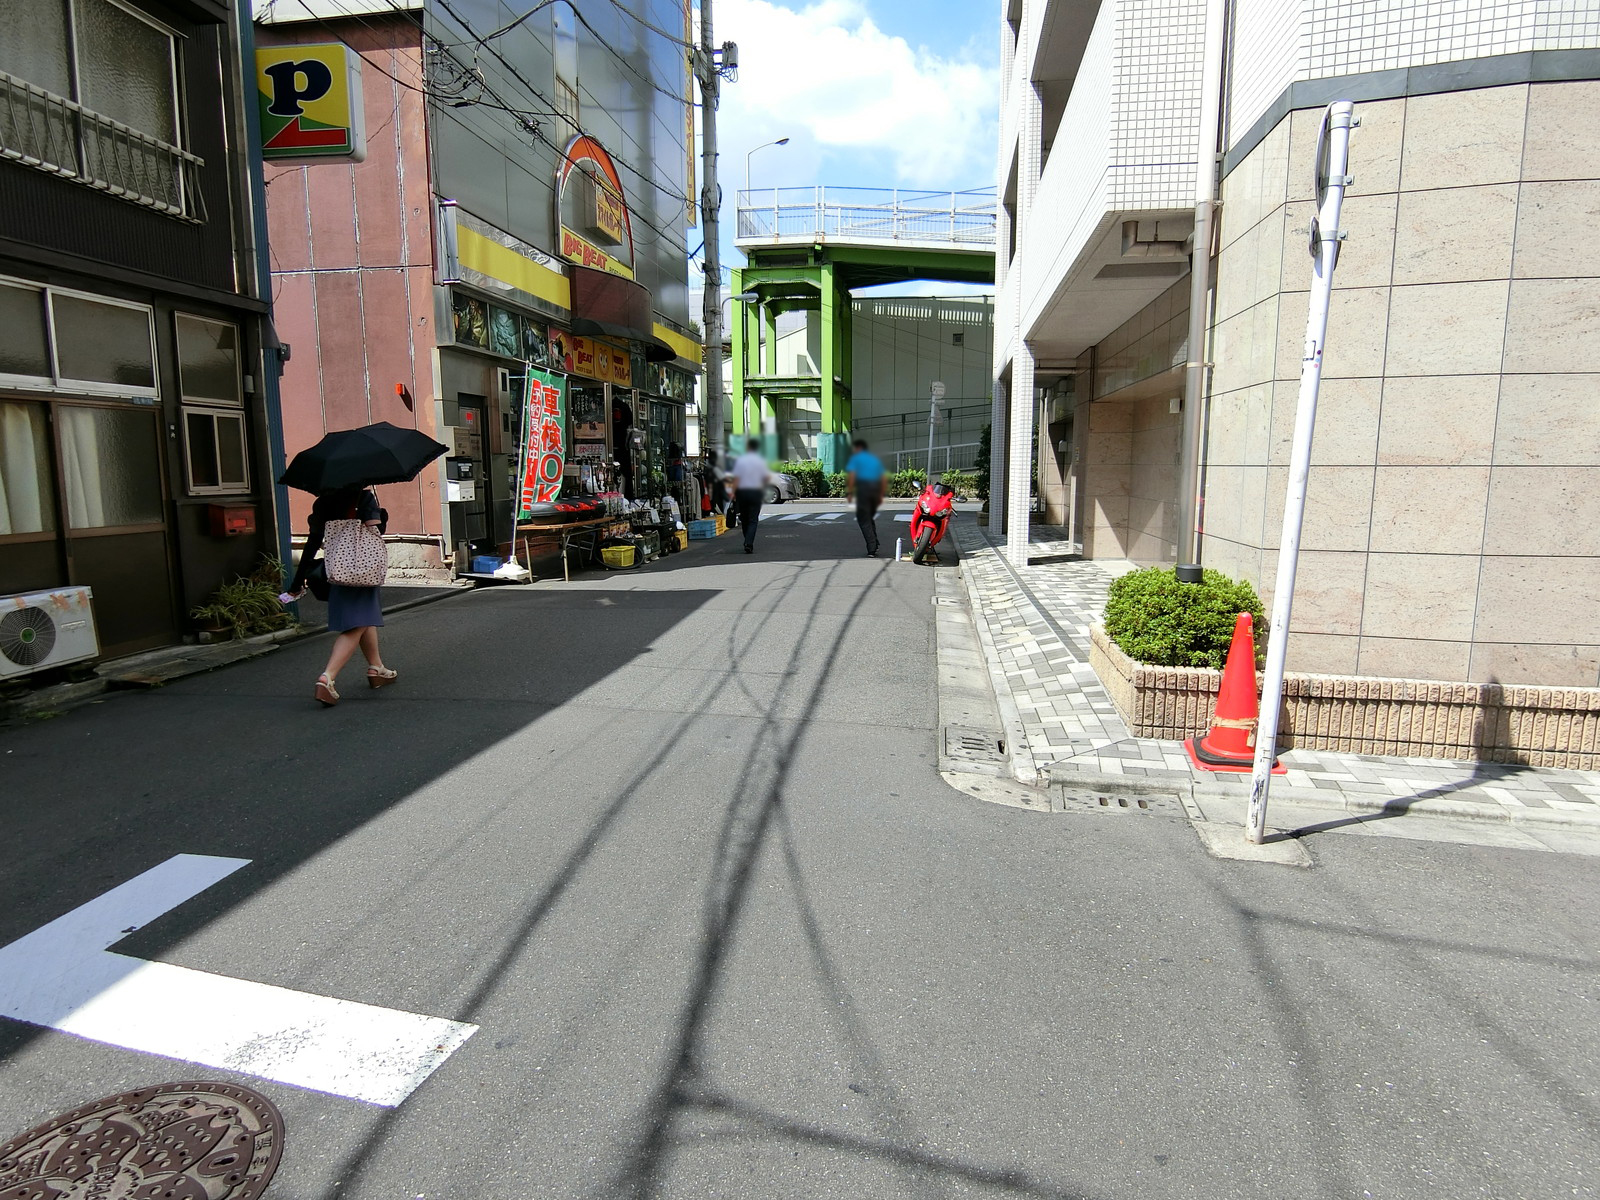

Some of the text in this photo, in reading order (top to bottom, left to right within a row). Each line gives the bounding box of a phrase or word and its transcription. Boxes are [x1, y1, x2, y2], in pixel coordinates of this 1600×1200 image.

[564, 232, 607, 270] BIG BEAT
[573, 337, 584, 351] BIG
[578, 351, 593, 364] BEAT
[536, 385, 564, 503] 車検OK
